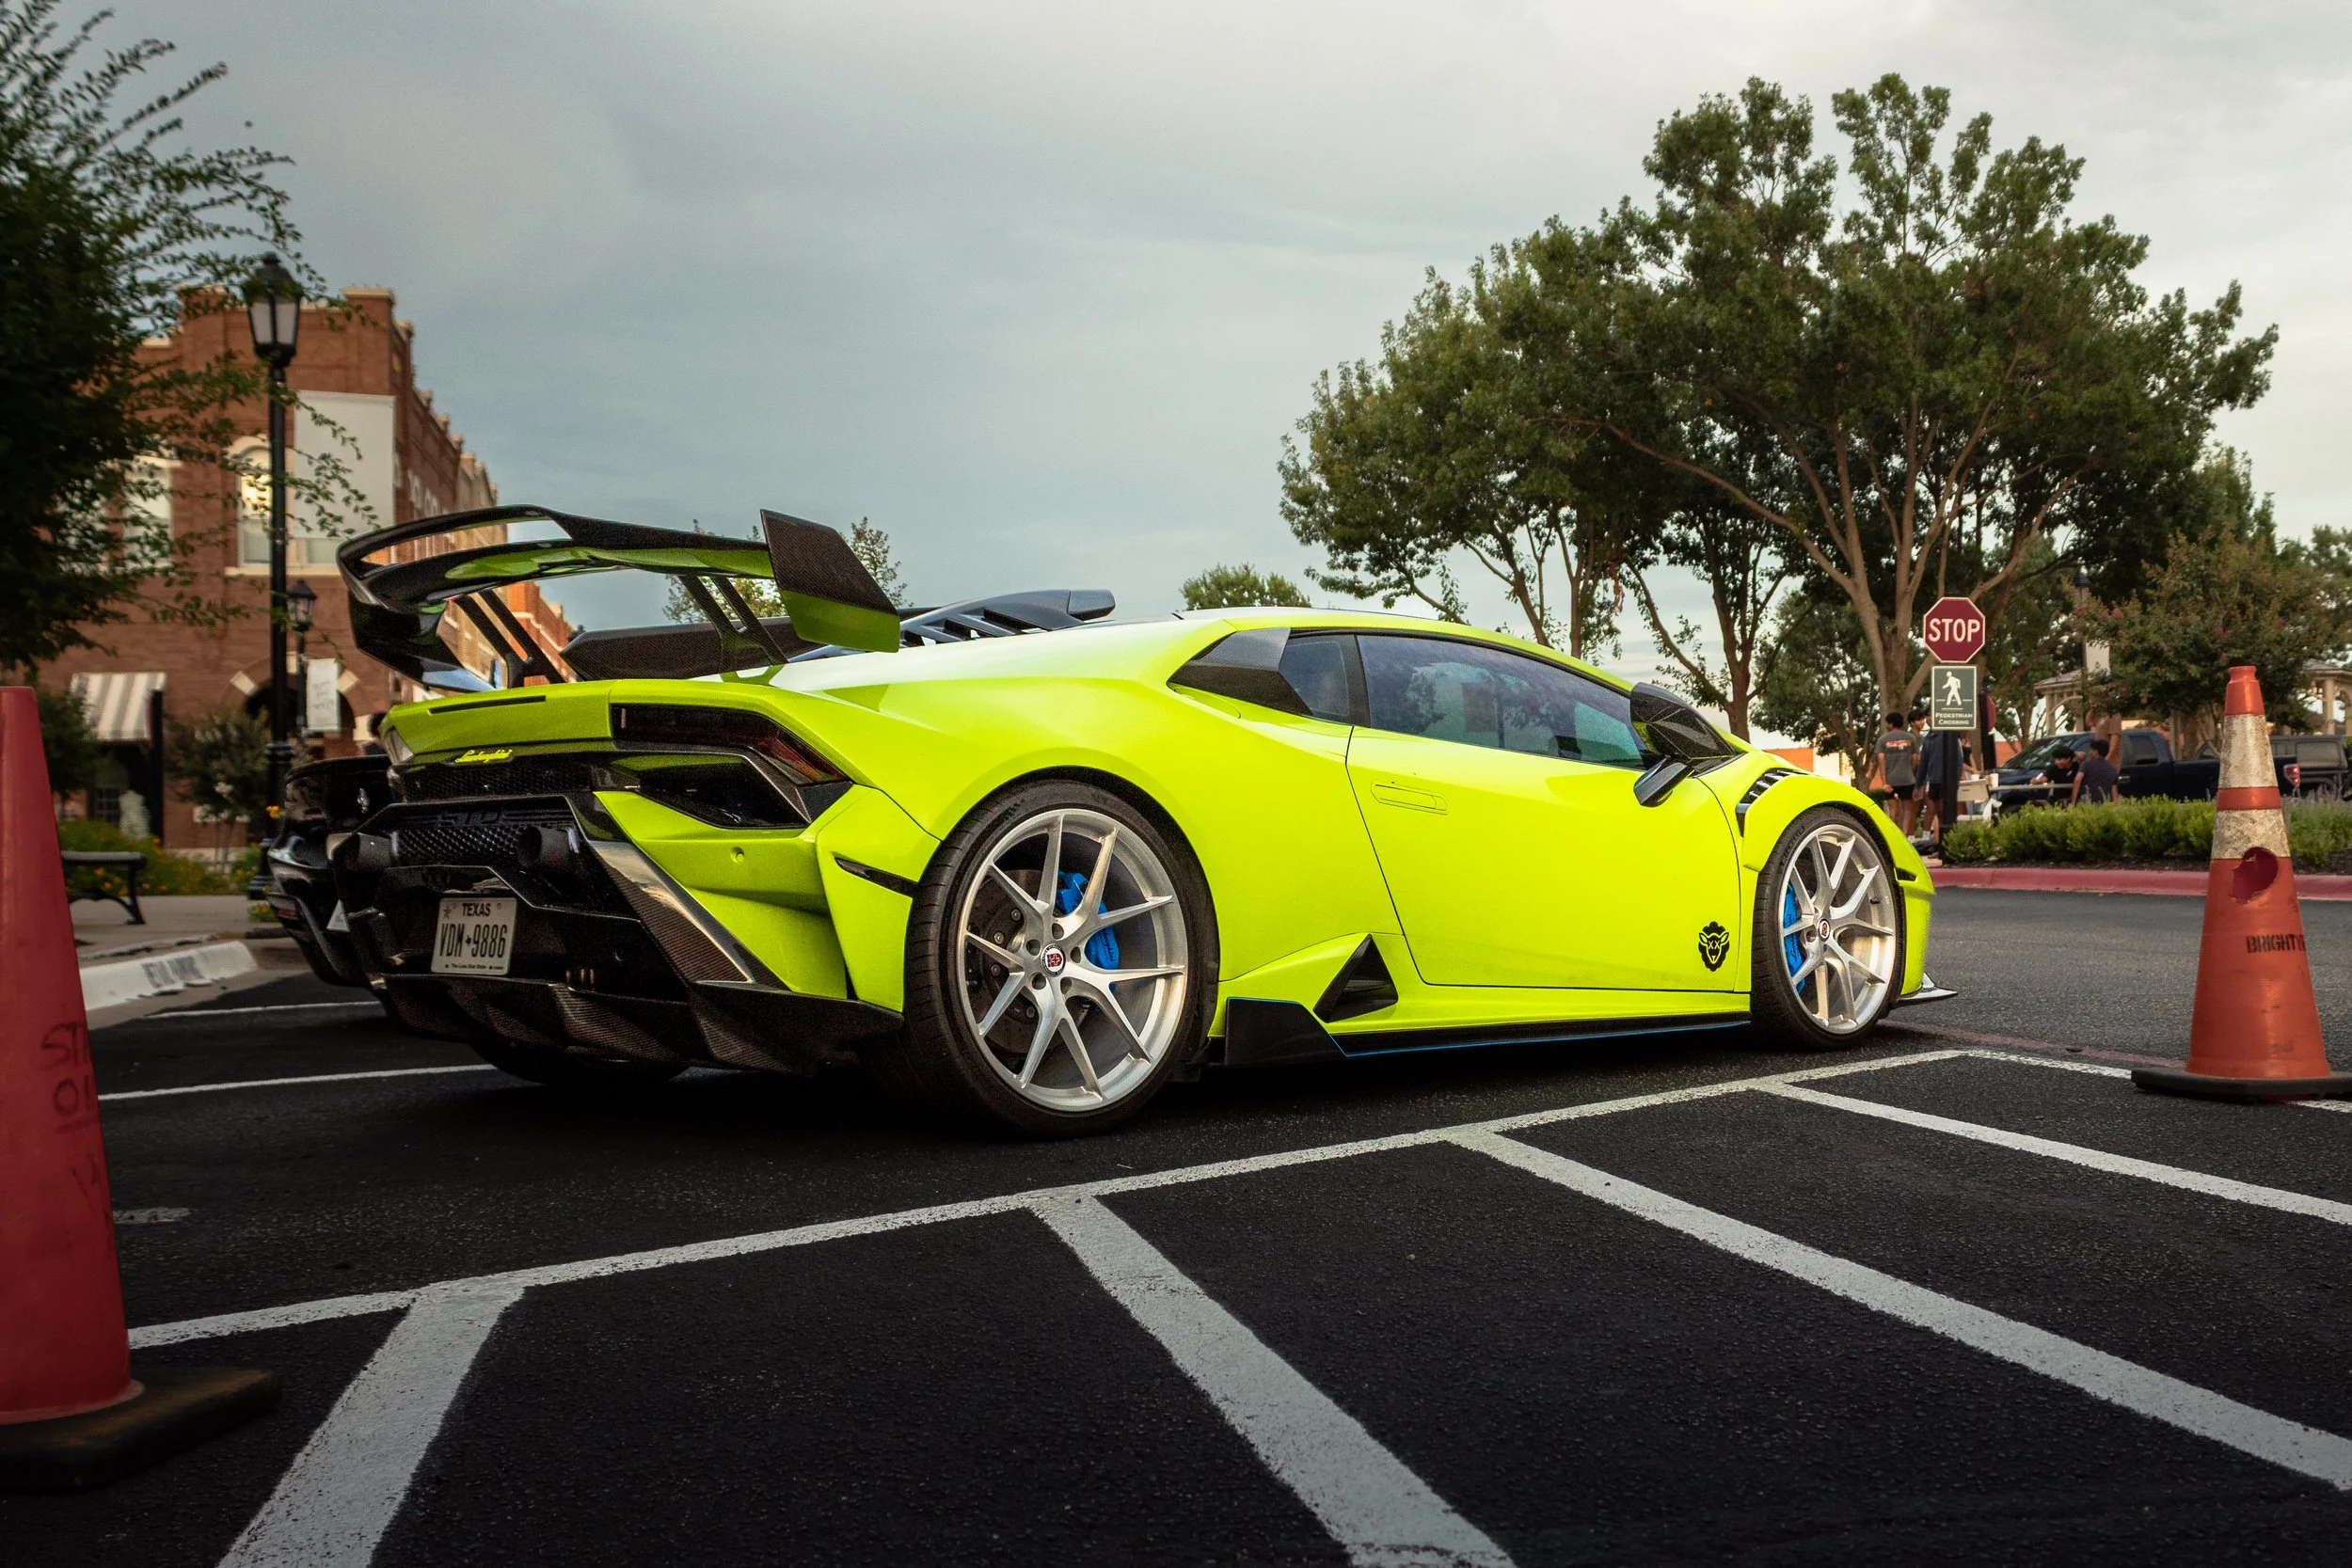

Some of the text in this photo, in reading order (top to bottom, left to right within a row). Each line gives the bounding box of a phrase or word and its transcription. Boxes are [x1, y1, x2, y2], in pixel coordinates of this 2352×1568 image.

[1929, 618, 1980, 642] STOP
[462, 903, 491, 917] TEXAS
[471, 924, 508, 958] 9886
